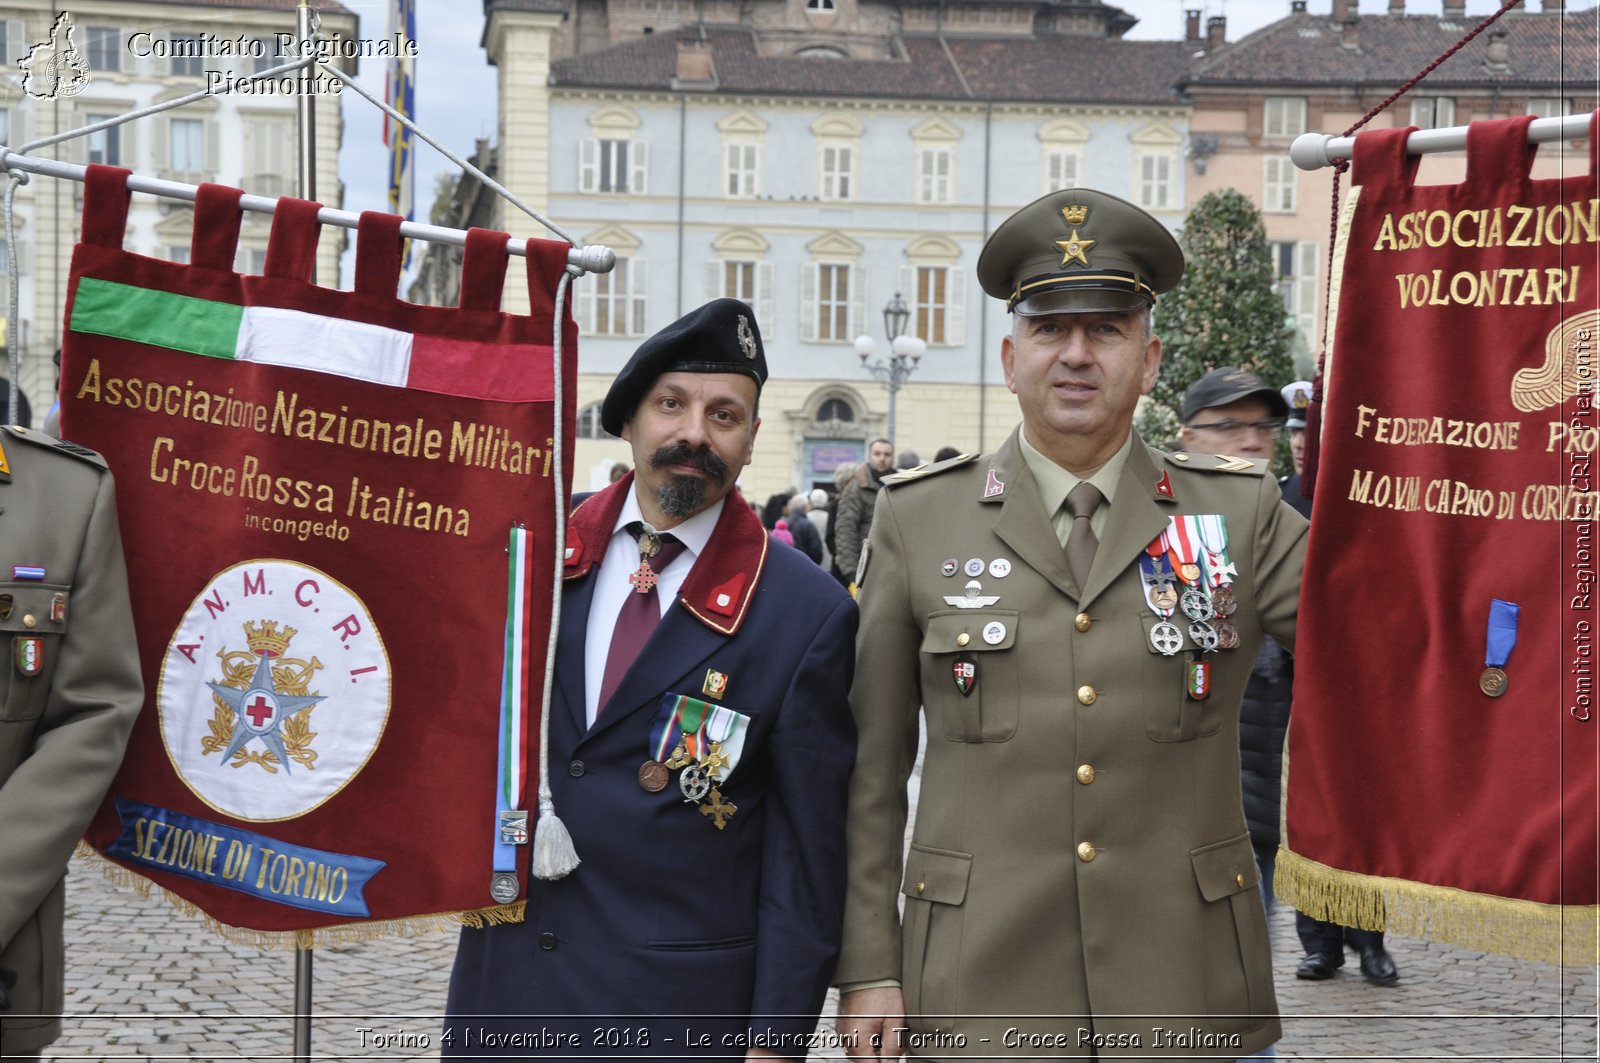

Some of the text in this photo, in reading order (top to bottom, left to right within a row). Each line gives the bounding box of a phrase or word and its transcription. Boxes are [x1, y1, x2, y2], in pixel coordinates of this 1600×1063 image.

[1373, 198, 1600, 252] ASSOCIAZION
[1395, 265, 1581, 309] VOLONTARI
[76, 359, 554, 478] Associazione Nazionale Militari
[1354, 404, 1600, 453] FEDERAZIONE PRO
[149, 436, 471, 537] Croce Rossa Italiana
[1495, 491, 1516, 520] DI
[131, 816, 348, 904] SEZIONE DI TORINO
